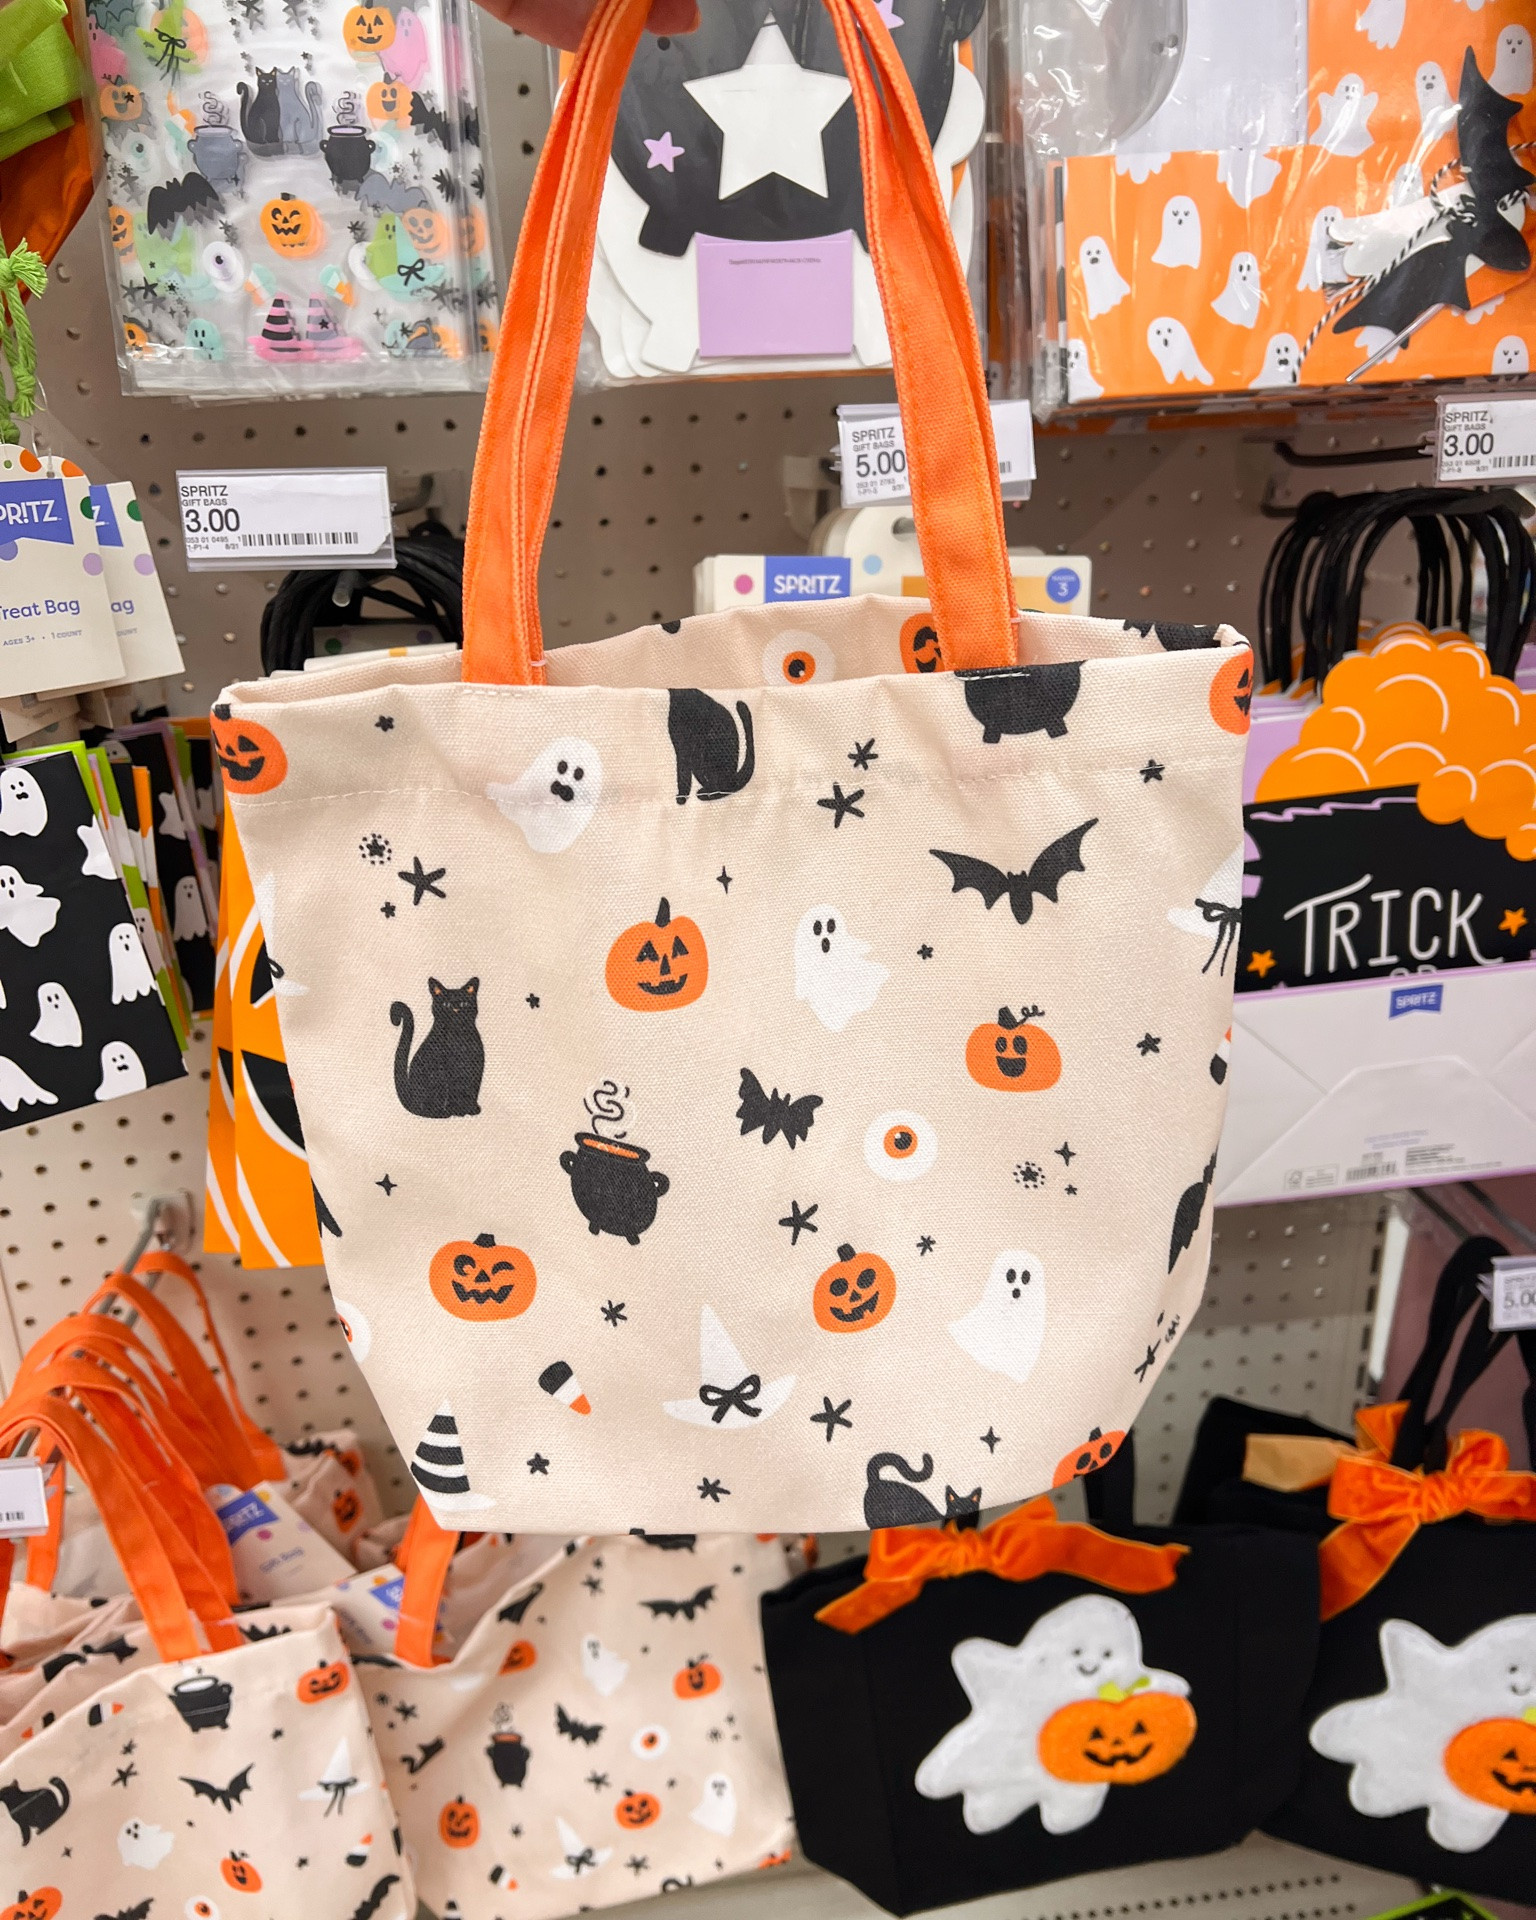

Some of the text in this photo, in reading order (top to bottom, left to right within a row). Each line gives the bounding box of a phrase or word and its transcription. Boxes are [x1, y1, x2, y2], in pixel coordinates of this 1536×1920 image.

[1444, 410, 1488, 423] SPRITZ
[852, 426, 896, 443] SPRITZ
[852, 440, 895, 452] GIFT BAGS
[1444, 432, 1495, 457] 3.00
[856, 449, 906, 478] 5.00
[181, 485, 229, 498] SPRITZ
[182, 498, 228, 507] GIFT BAGS
[185, 508, 240, 533] 3.00
[773, 574, 842, 594] SPRITZ
[44, 599, 81, 615] Bag
[111, 600, 134, 615] ag
[3, 638, 24, 646] AGES
[1283, 873, 1504, 977] TRICK
